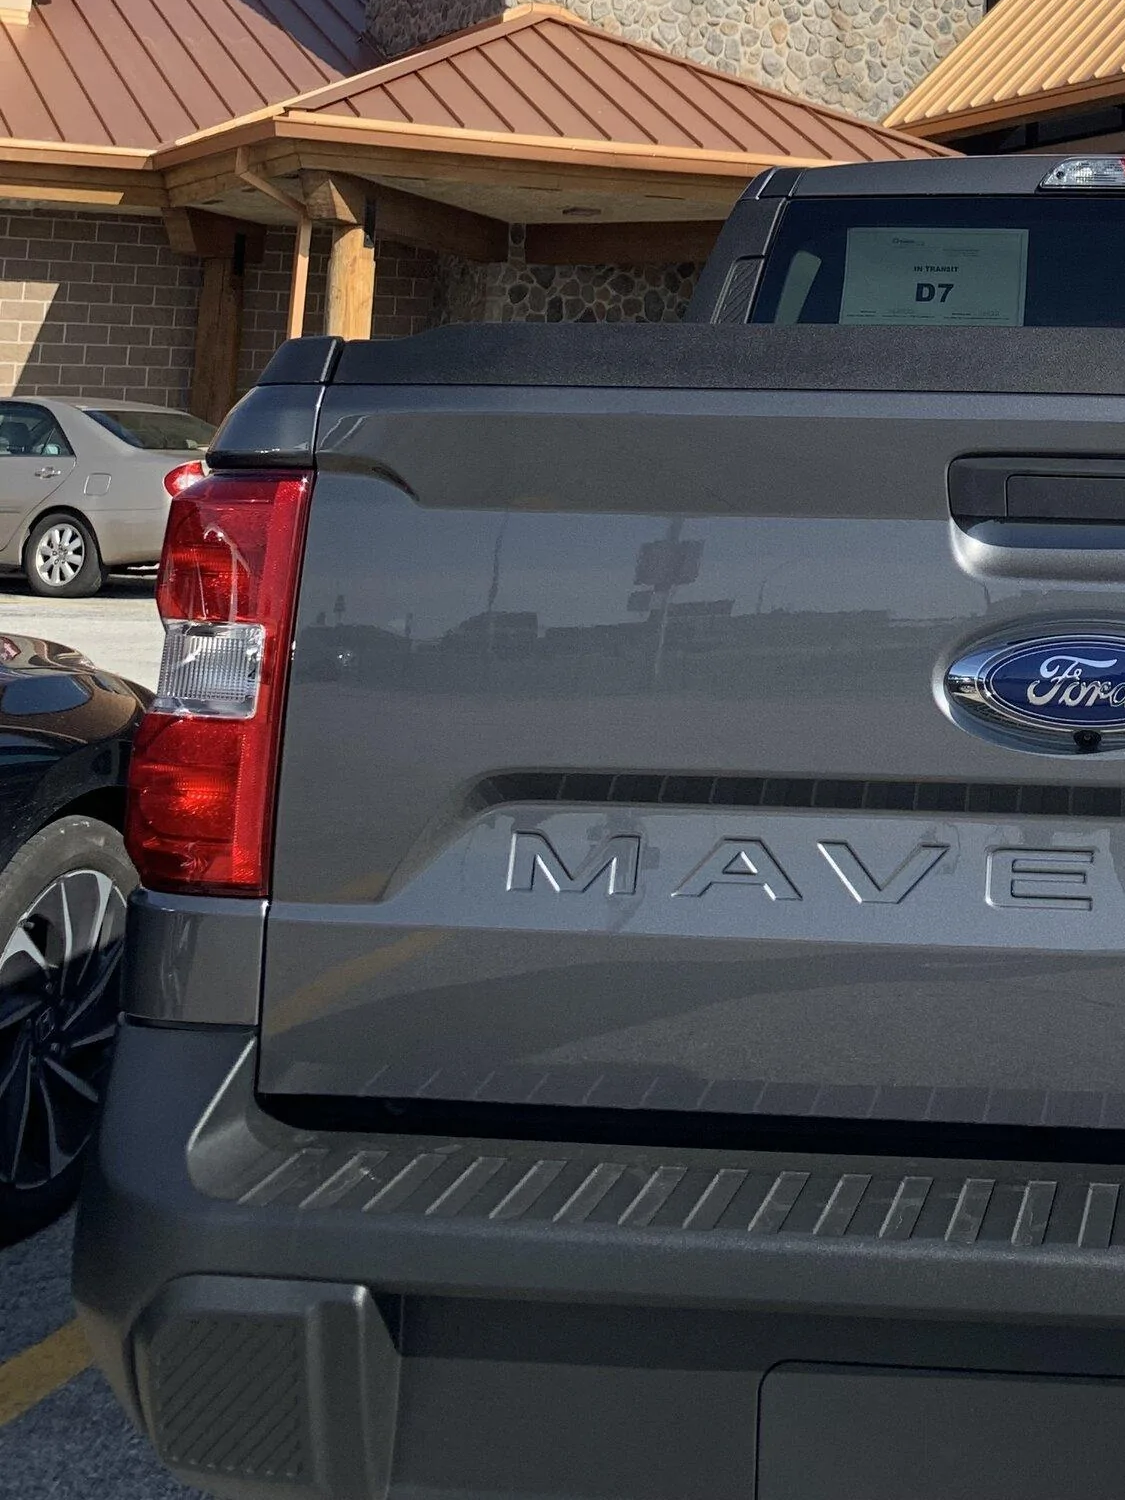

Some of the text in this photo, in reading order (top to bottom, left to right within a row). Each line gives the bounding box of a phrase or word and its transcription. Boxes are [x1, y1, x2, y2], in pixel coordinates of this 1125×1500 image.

[913, 265, 960, 273] IN TRANSIT
[915, 282, 955, 303] D7
